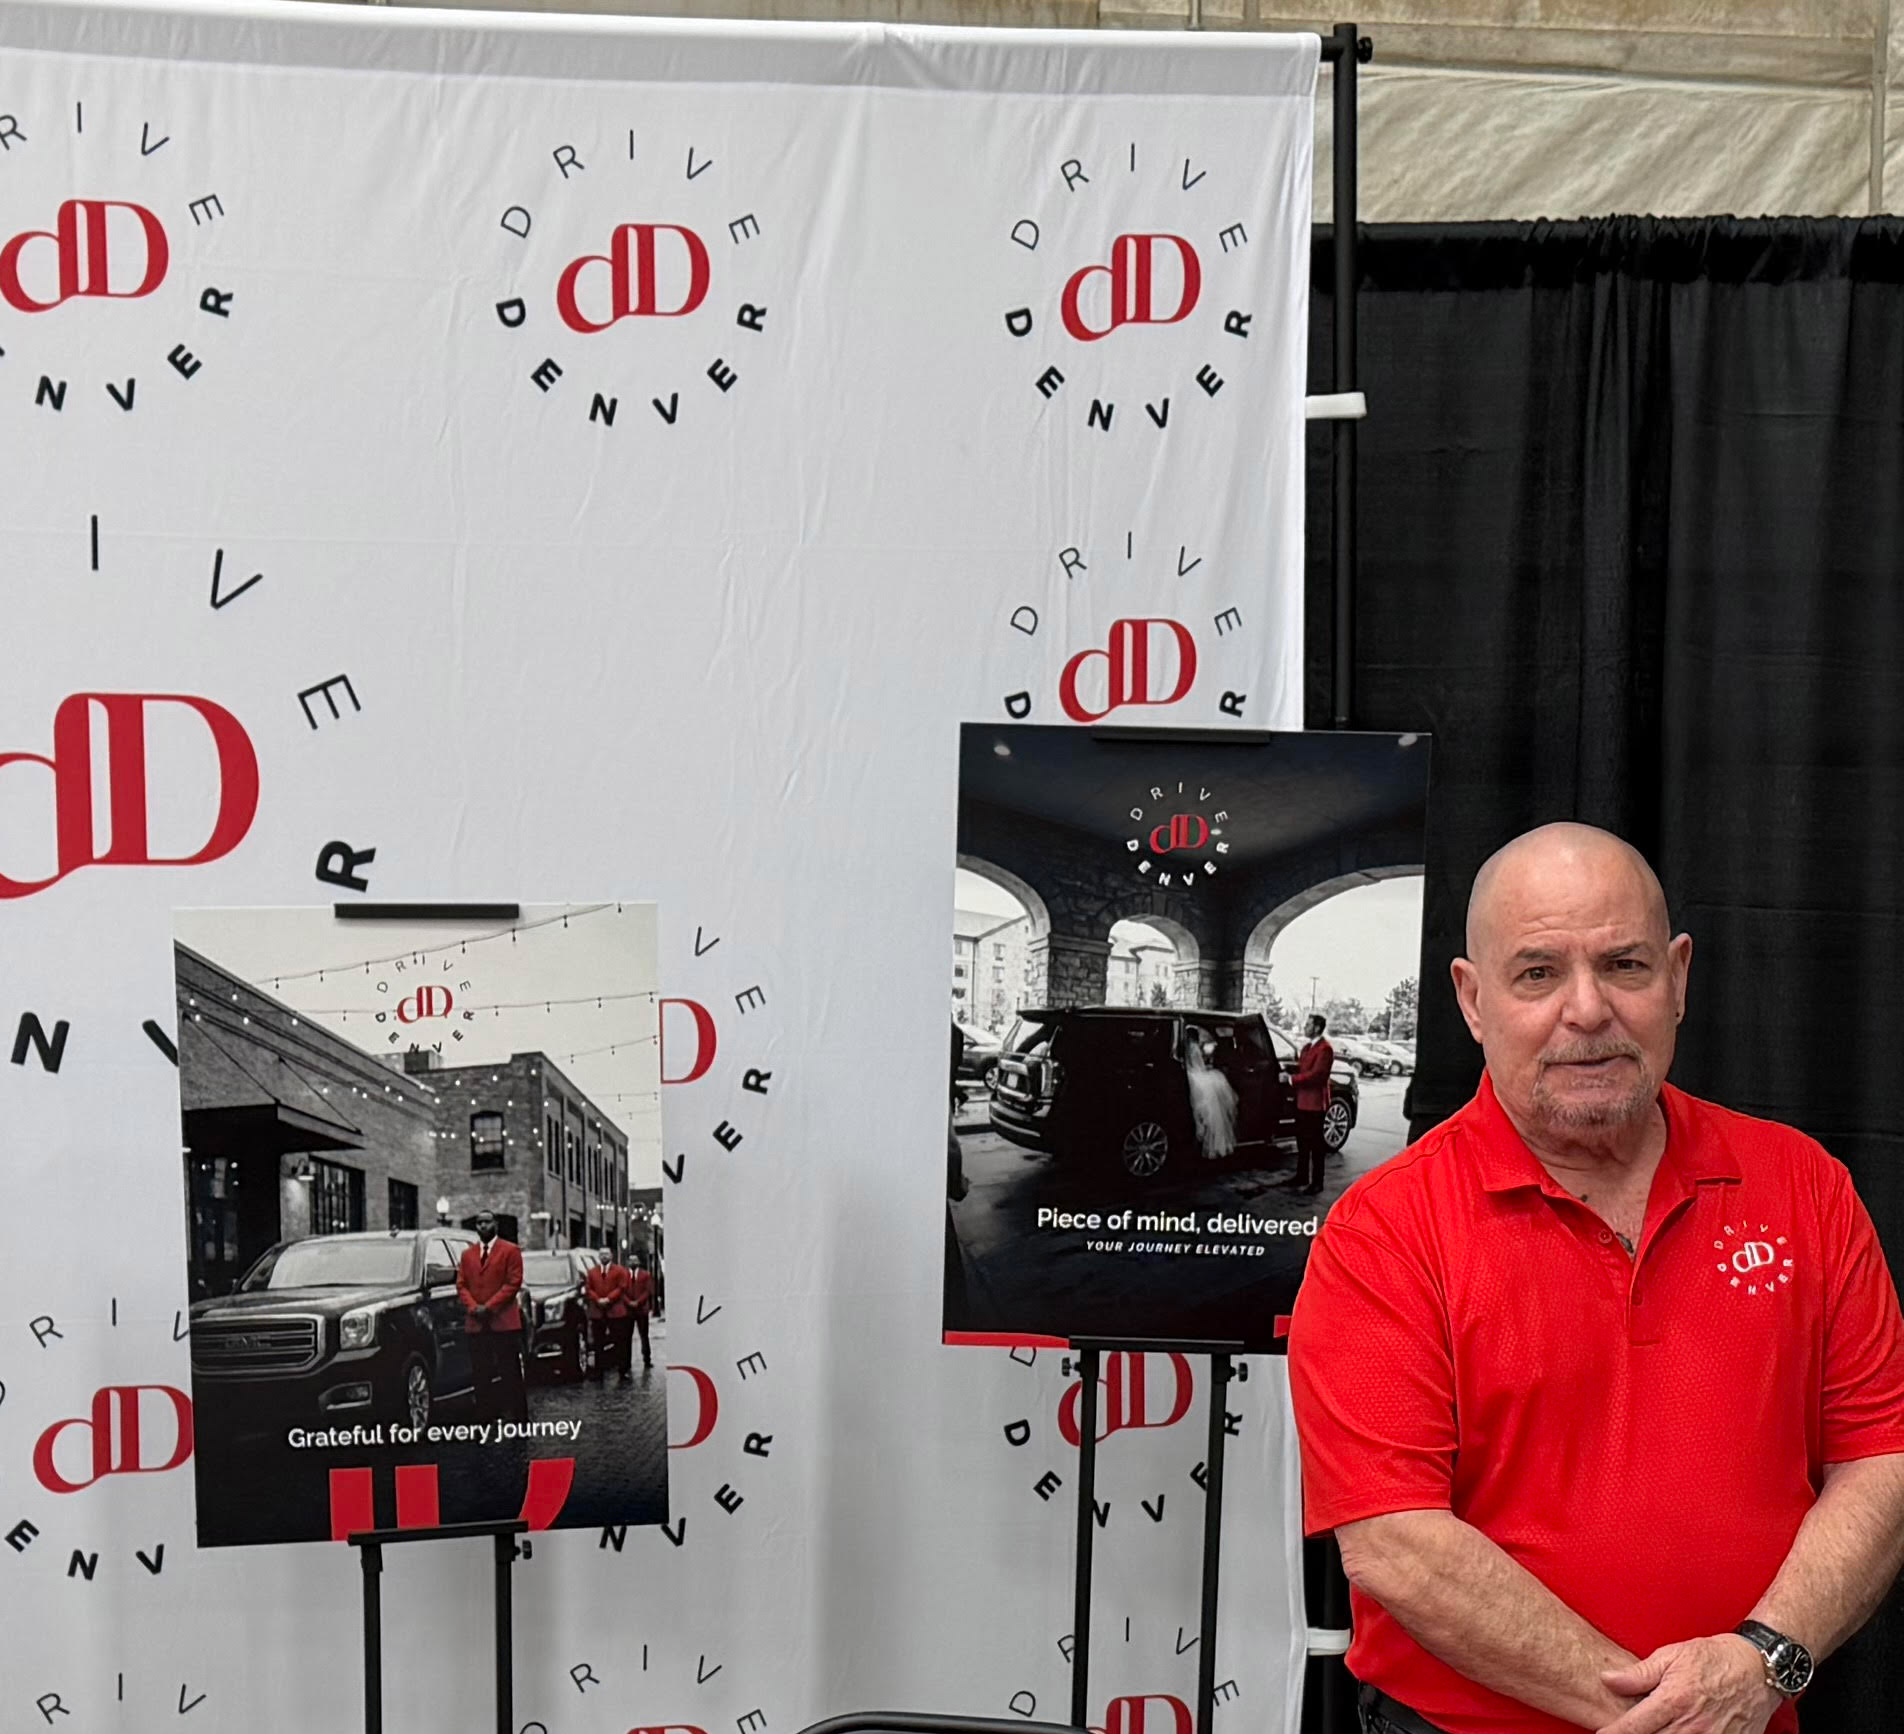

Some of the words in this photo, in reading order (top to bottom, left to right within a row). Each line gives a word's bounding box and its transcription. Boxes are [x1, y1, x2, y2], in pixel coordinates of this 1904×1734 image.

[1038, 1208, 1101, 1229] Piece
[1107, 1210, 1132, 1230] of
[1137, 1212, 1201, 1234] mind,
[1207, 1213, 1317, 1236] delivered
[1087, 1240, 1123, 1251] YOUR
[1128, 1241, 1190, 1253] JOURNEY
[1196, 1244, 1264, 1256] ELEVATED
[289, 1425, 383, 1447] Grateful
[389, 1421, 421, 1443] for
[428, 1425, 490, 1444] every
[495, 1419, 581, 1442] journey
